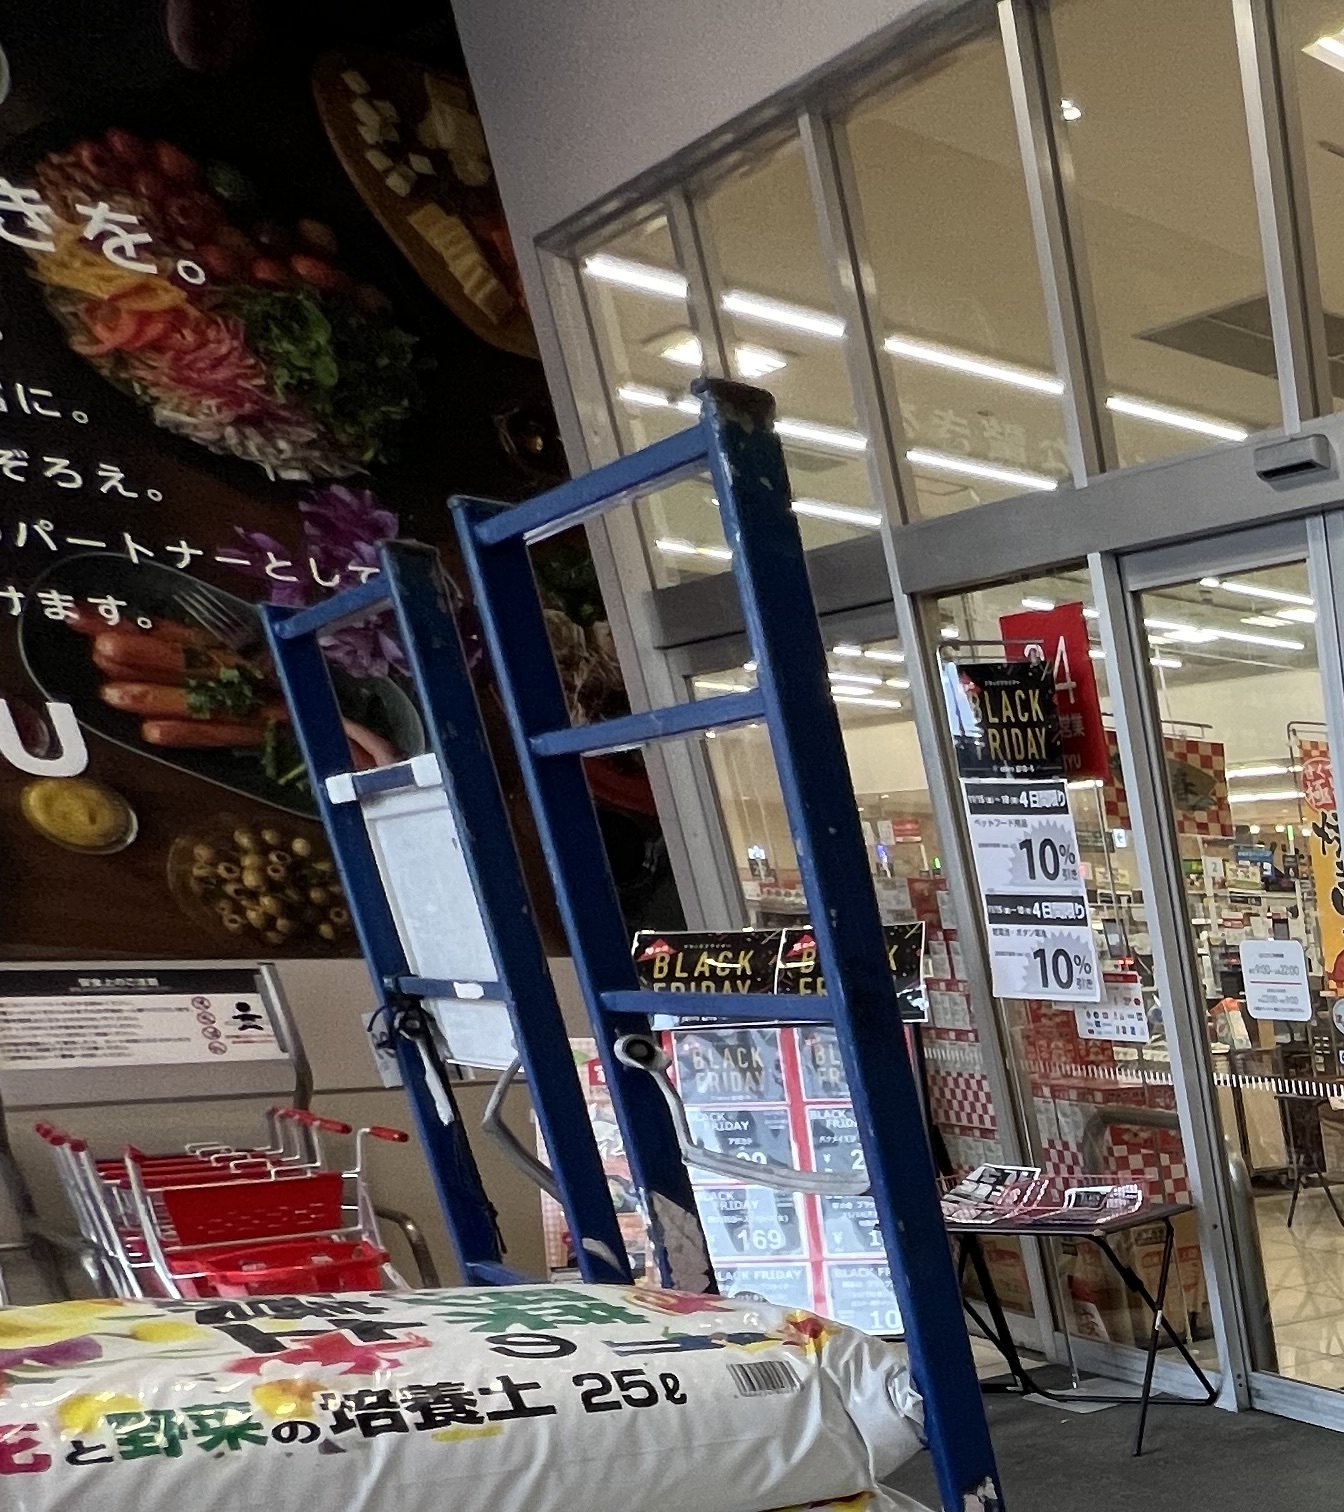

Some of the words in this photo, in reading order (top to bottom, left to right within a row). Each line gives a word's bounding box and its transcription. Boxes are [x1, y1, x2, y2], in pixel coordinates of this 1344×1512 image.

[1018, 837, 1076, 882] 10%
[652, 949, 755, 979] BLACK
[1032, 948, 1092, 991] 10%
